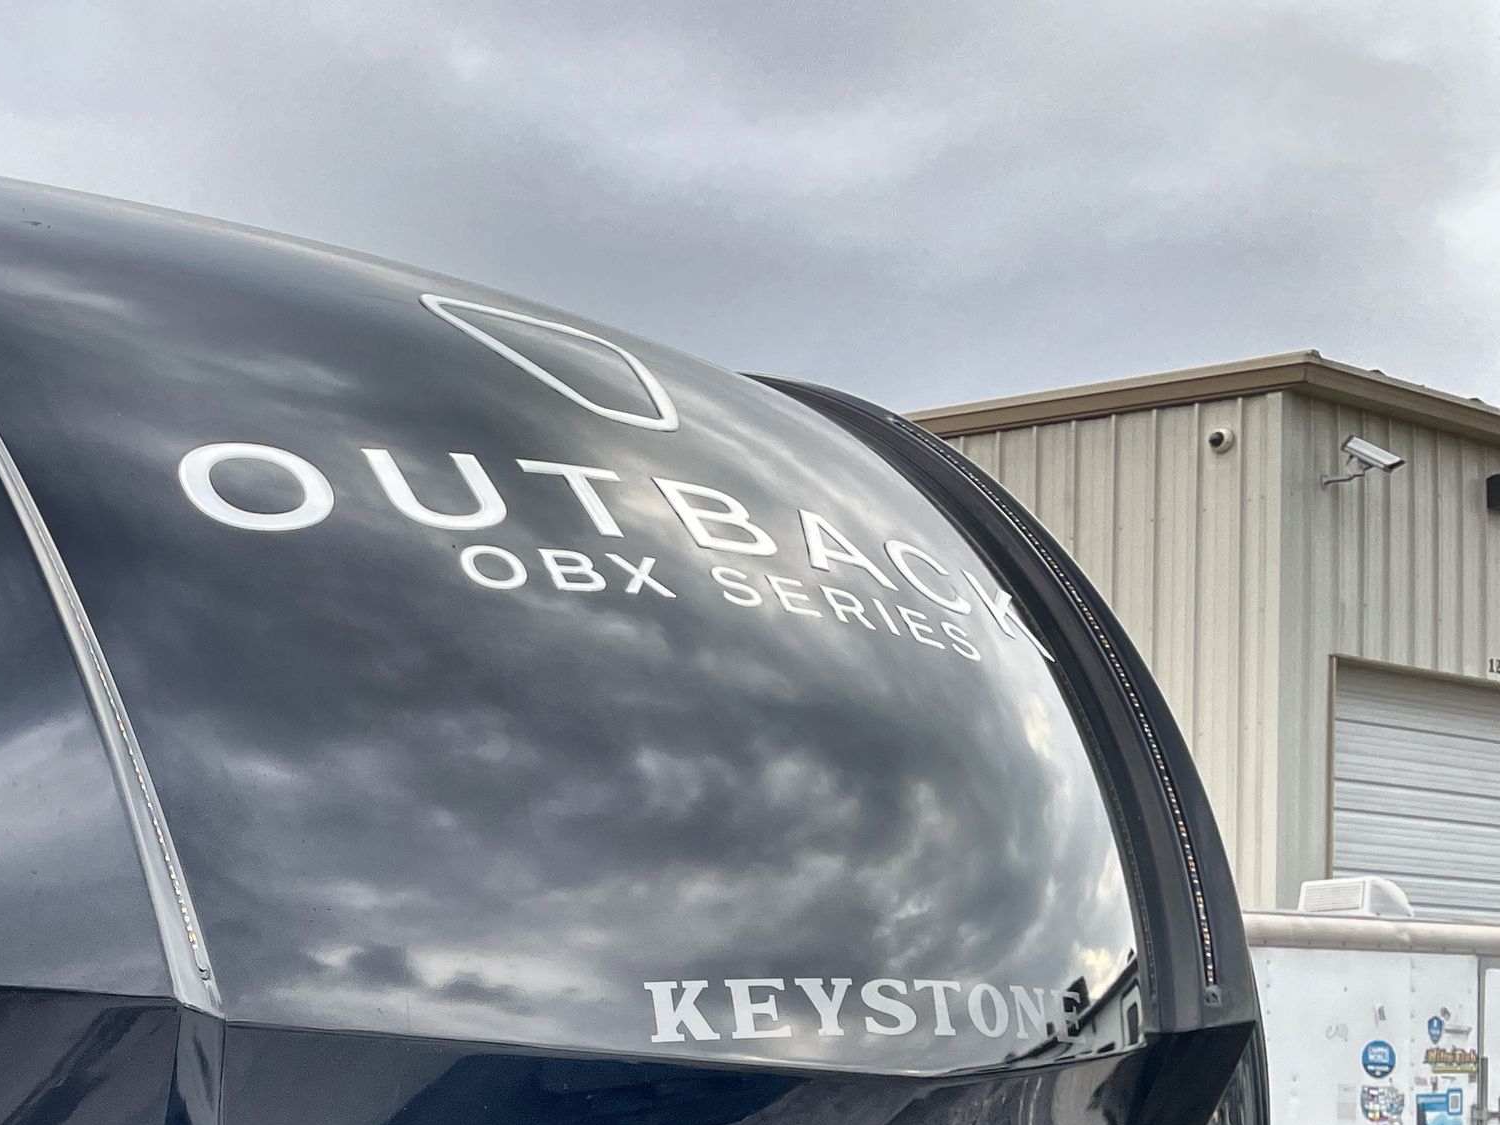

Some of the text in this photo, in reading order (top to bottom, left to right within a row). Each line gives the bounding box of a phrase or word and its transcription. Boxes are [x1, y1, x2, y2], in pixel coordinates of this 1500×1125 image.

[177, 441, 1056, 663] OUTBACK
[460, 545, 982, 662] OBX SERIES
[643, 978, 1086, 1045] KEYSTONE
